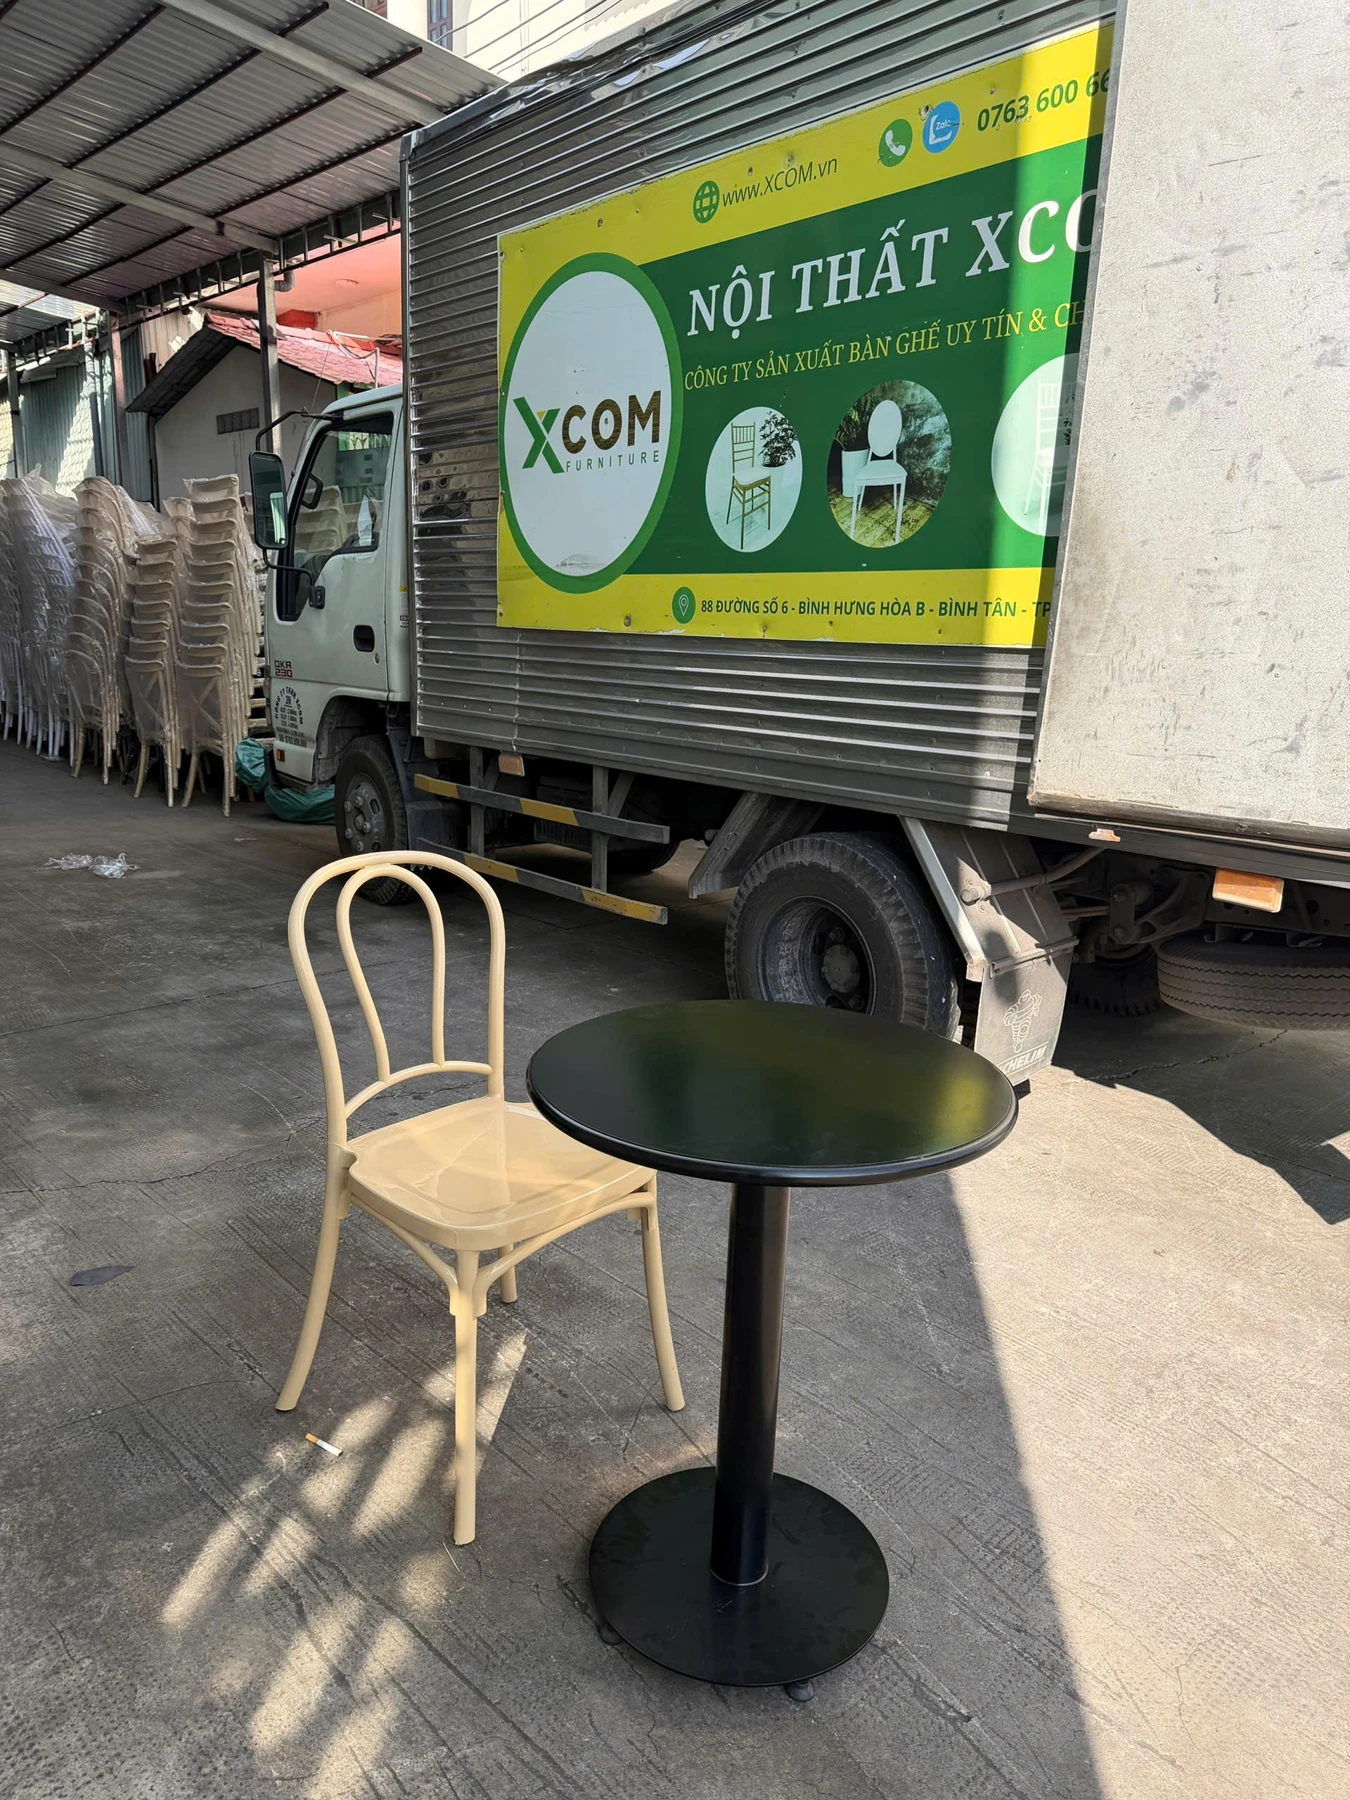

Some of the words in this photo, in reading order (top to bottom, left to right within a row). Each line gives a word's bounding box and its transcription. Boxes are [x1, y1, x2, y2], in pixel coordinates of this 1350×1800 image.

[977, 95, 1030, 132] 0763
[1036, 79, 1079, 113] 600
[722, 158, 838, 207] www.XCOM.vn
[687, 264, 775, 340] NỘI
[791, 218, 949, 314] THẤT
[684, 364, 728, 390] CÔNG
[731, 361, 753, 383] TY
[755, 350, 791, 379] SẢN
[793, 339, 845, 372] XUẤT
[848, 333, 891, 363] BÀN
[895, 319, 941, 355] GHẾ
[946, 320, 977, 346] UY
[982, 308, 1024, 341] TÍN
[1028, 308, 1047, 333] &
[512, 390, 662, 474] XCOM
[566, 450, 660, 473] FURNITURE
[701, 600, 714, 613] 88
[716, 596, 760, 614] ĐƯỜNG
[763, 596, 779, 614] SỐ
[781, 601, 789, 614] 6
[798, 598, 830, 615] BÌNH
[834, 600, 876, 616] HƯNG
[880, 598, 912, 616] HÒA
[916, 602, 926, 616] B
[938, 598, 978, 617] BÌNH
[983, 598, 1017, 617] TÂN
[1032, 602, 1051, 617] TP
[275, 668, 293, 678] 230
